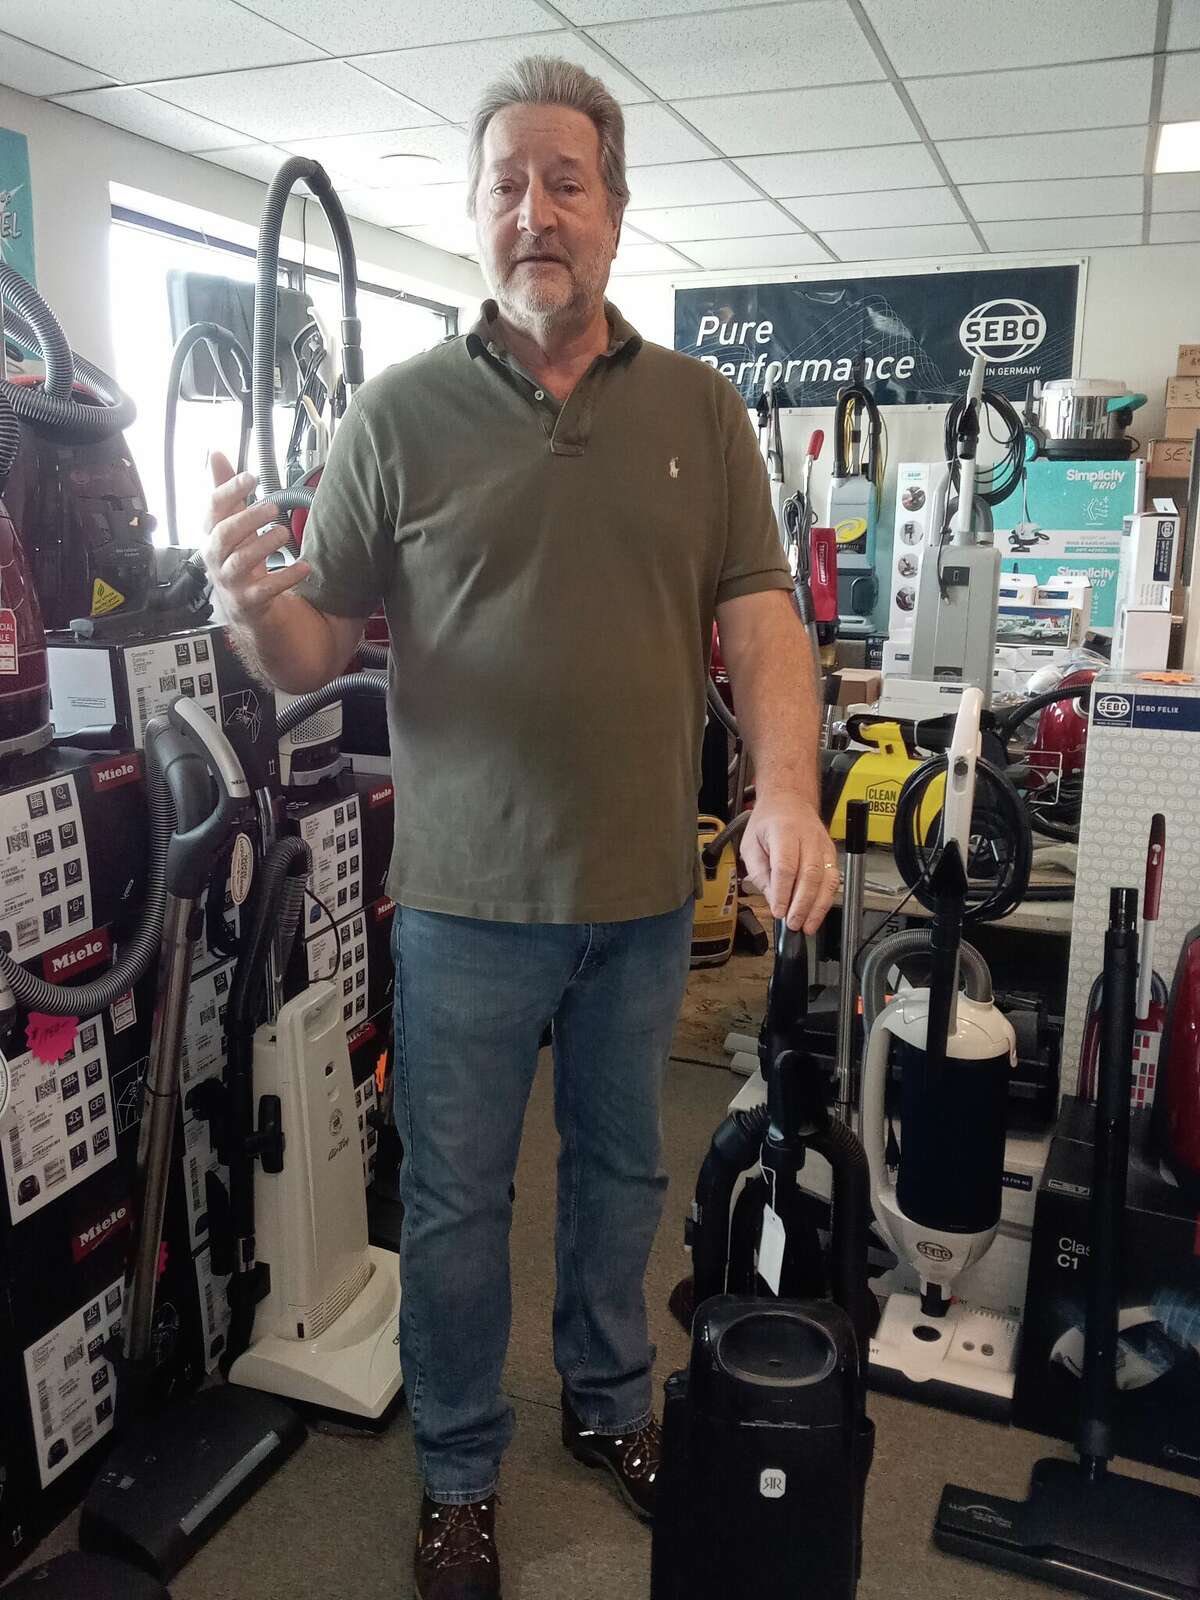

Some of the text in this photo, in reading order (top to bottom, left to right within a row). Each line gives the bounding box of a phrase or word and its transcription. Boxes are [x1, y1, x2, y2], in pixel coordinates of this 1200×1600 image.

[696, 316, 774, 346] Pure
[965, 318, 1041, 343] SEBO
[985, 367, 995, 376] IN
[998, 366, 1041, 376] GERMANY
[1066, 468, 1125, 484] Simplicity
[1099, 702, 1179, 714] SEBO SEBO FELIX
[97, 764, 135, 783] Miele
[372, 787, 393, 802] Miele
[868, 788, 897, 802] CLEAN
[868, 800, 896, 814] OBSES
[52, 940, 103, 972] Miele
[80, 1206, 127, 1246] Miele
[1057, 1253, 1079, 1270] C1
